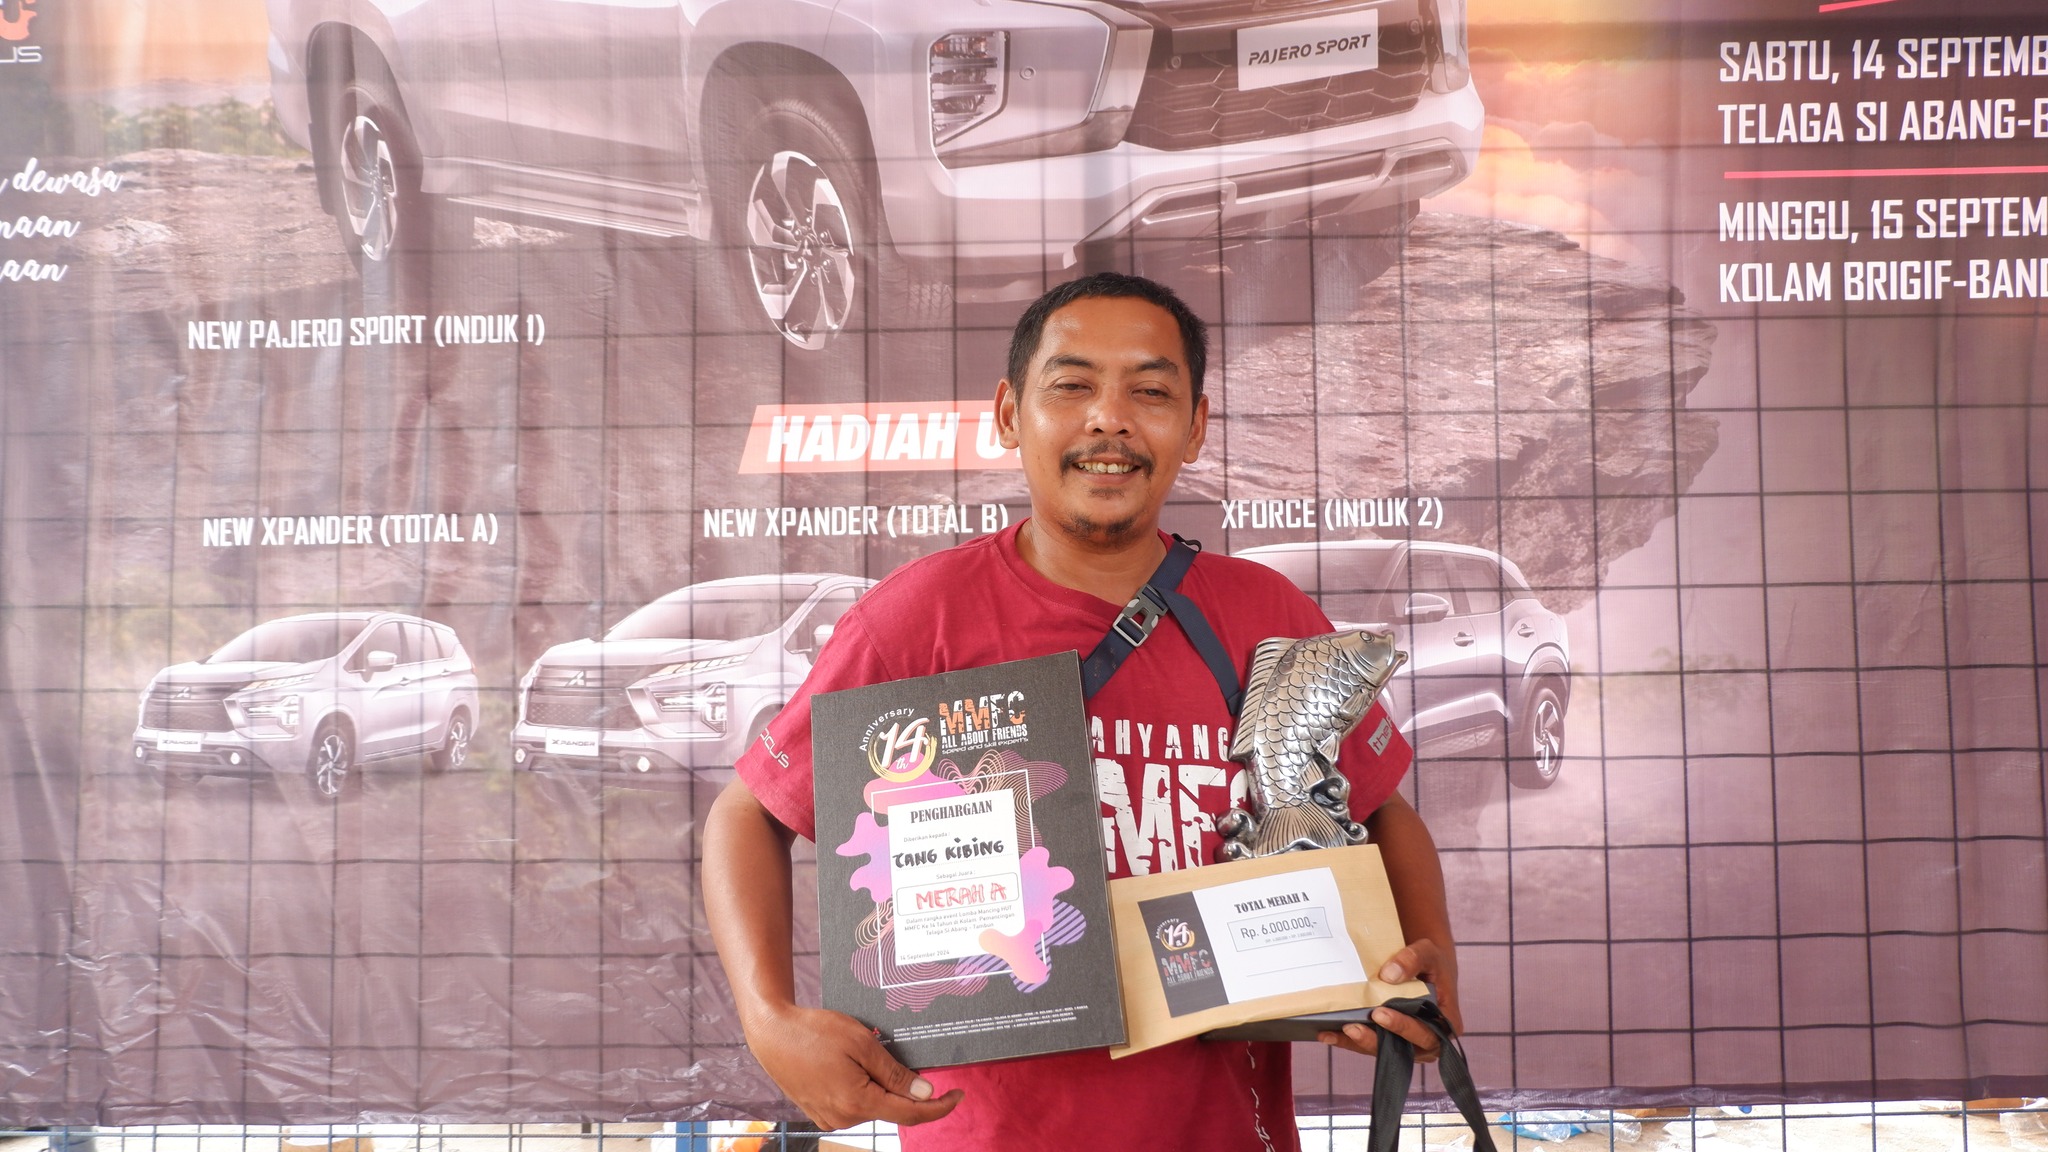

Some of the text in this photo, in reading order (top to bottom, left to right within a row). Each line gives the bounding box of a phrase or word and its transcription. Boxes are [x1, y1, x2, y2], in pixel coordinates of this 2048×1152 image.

[1248, 34, 1371, 66] PAJERO SPORT
[1719, 39, 1840, 85] SABTU,
[1852, 38, 1886, 80] 14
[1717, 102, 1845, 144] TELAGA
[1855, 101, 1888, 142] SI
[12, 156, 123, 197] dewasa
[1719, 196, 2048, 244] MINGGU, 15 SEPTEM
[1719, 260, 1832, 303] KOLAM
[187, 313, 546, 350] NEW PAJERO SPORT (INDUK 1)
[766, 411, 961, 463] HADIAH
[203, 512, 499, 547] NEW XPANDER (TOTAL A)
[703, 502, 1009, 539] NEW XPANDER (TOTAL B)
[1221, 496, 1444, 531] XFORCE (INDUK 2)
[859, 707, 915, 752] Anniversary
[938, 690, 1026, 737] MMFC
[879, 717, 931, 769] 14
[941, 723, 1029, 750] ALL ABOUT FRIENDS
[941, 745, 967, 756] speed
[967, 743, 984, 751] and
[895, 756, 909, 770] th
[910, 799, 993, 824] PENGHARGAAN
[903, 834, 929, 843] Diberikan
[915, 882, 1007, 910] MERAH A
[1233, 891, 1310, 914] TOTAL MERAH A
[1240, 927, 1260, 940] Rp.
[1261, 916, 1318, 935] 6.000.000,-
[1160, 948, 1213, 977] MMFC
